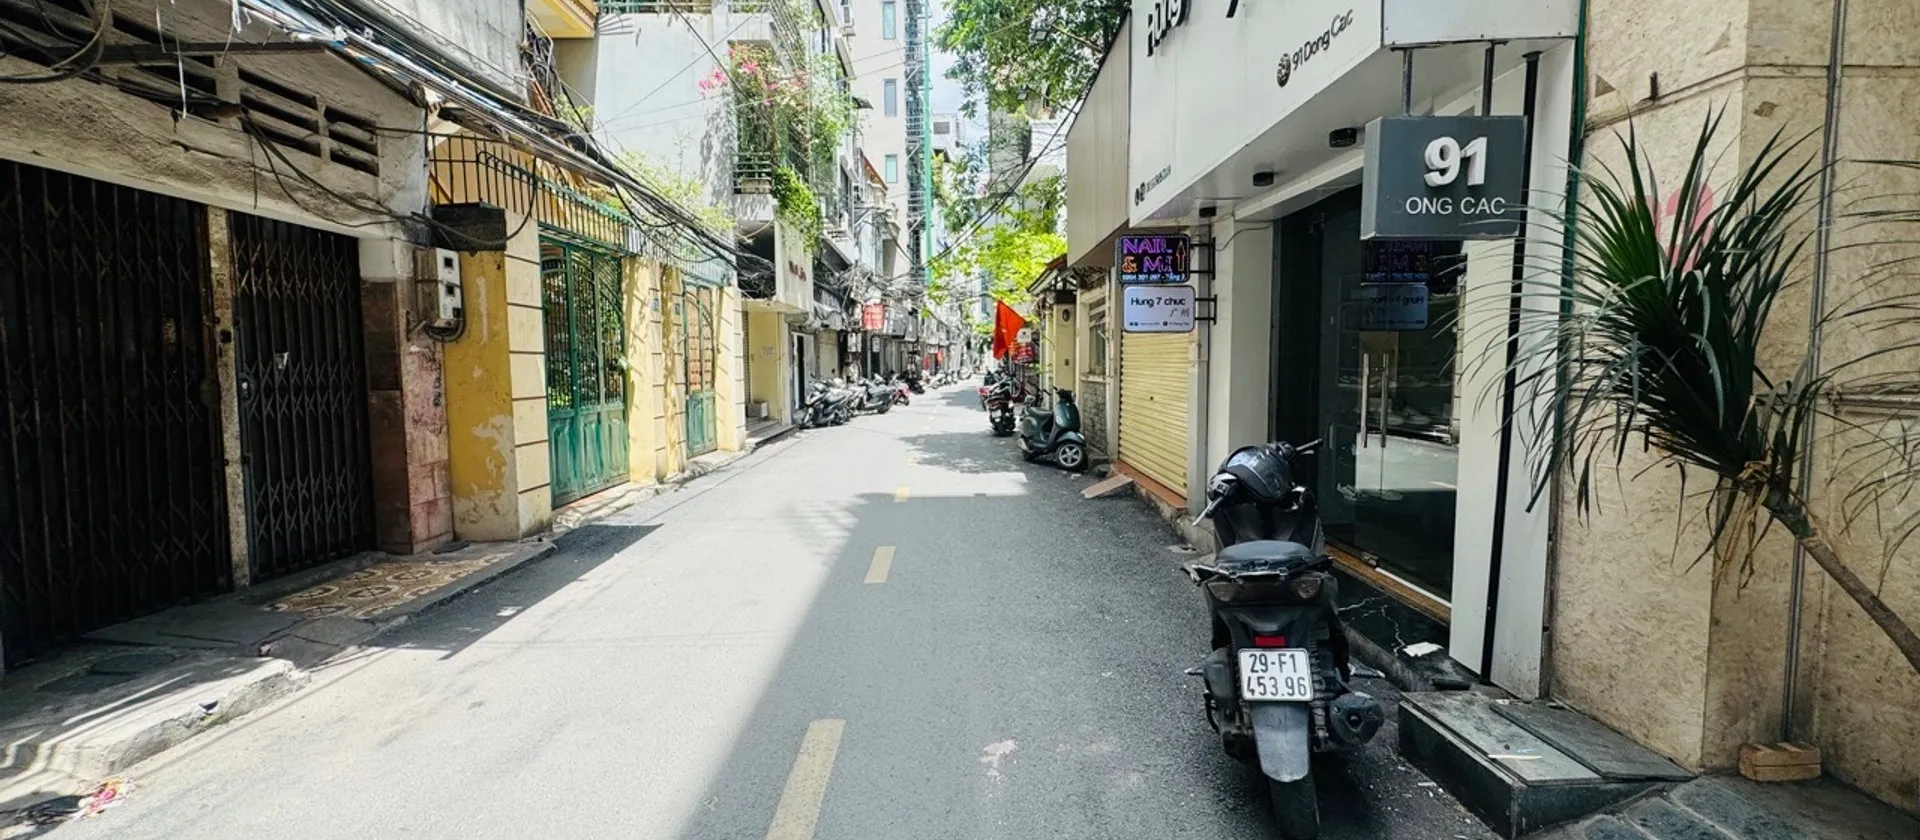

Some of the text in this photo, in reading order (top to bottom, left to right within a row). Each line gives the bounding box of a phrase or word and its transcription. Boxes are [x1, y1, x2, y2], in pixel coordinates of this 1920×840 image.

[1292, 8, 1354, 71] 91 Dong Cac
[1423, 136, 1488, 187] 91
[1460, 196, 1506, 215] CAC
[1123, 238, 1173, 254] NAIL
[1121, 255, 1138, 273] &
[1131, 297, 1186, 308] Hung 7 chuc
[1249, 653, 1297, 673] 29-F1
[1247, 676, 1307, 697] 453.96
